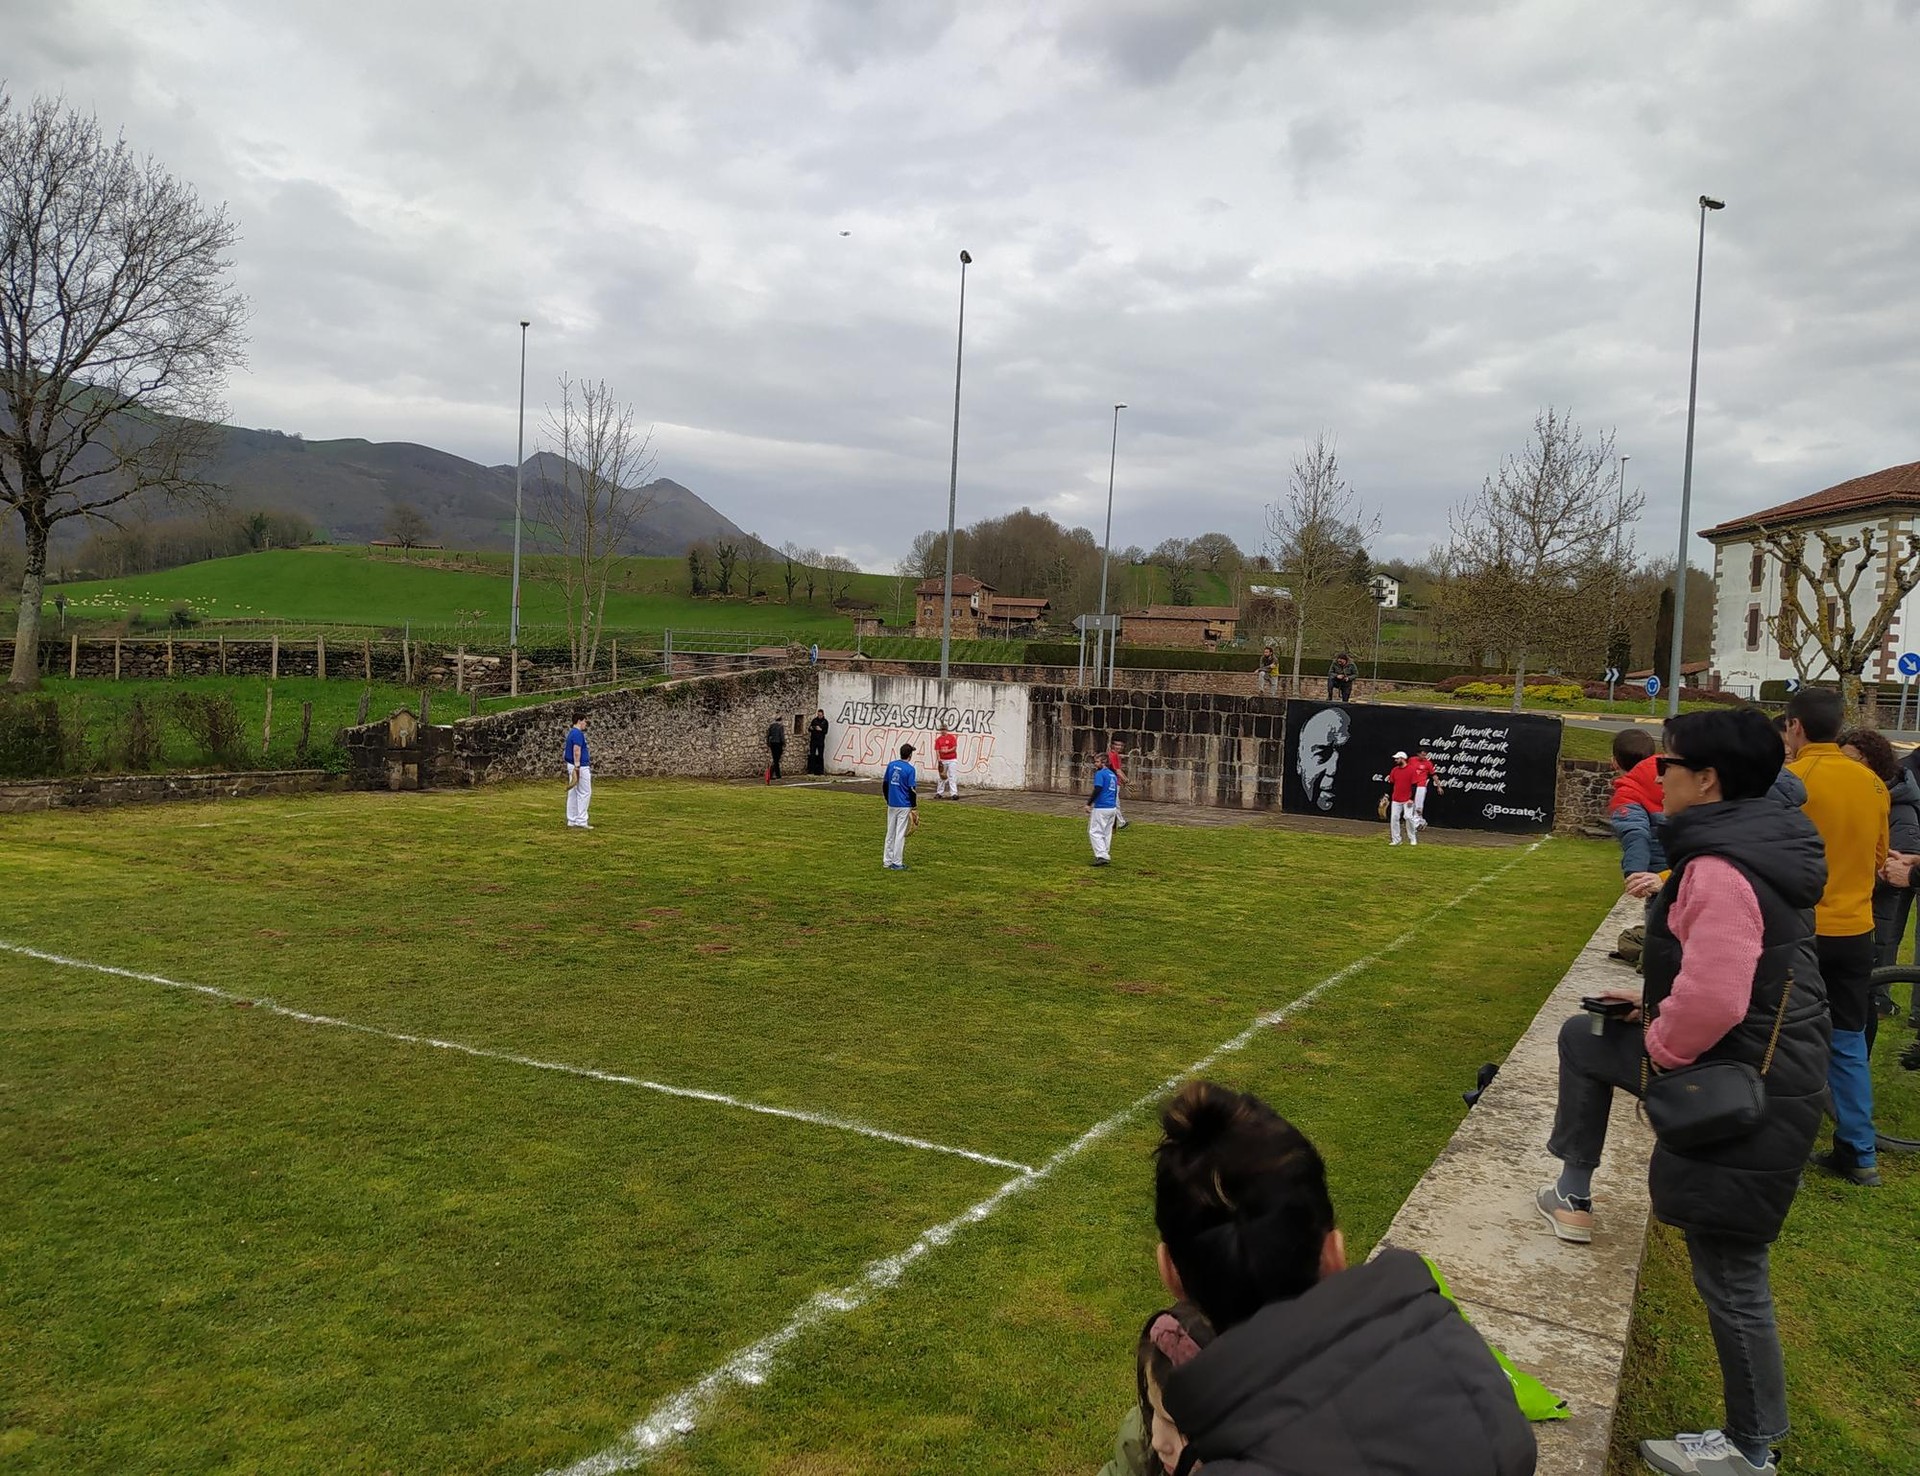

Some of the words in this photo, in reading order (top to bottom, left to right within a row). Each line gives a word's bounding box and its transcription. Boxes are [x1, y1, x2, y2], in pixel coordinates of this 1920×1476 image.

[837, 701, 995, 735] ALTSASUKOAK
[1492, 728, 1509, 739] ez!
[833, 725, 996, 776] ASKAU!
[1419, 738, 1431, 746] ez
[1432, 737, 1457, 751] dago
[1459, 738, 1509, 754] itzultzerik
[1452, 751, 1479, 764] atean
[1480, 754, 1506, 768] dago
[1447, 764, 1474, 776] hotza
[1475, 767, 1506, 780] dakar
[1464, 781, 1507, 794] goizerik
[1493, 805, 1536, 817] Bozate
